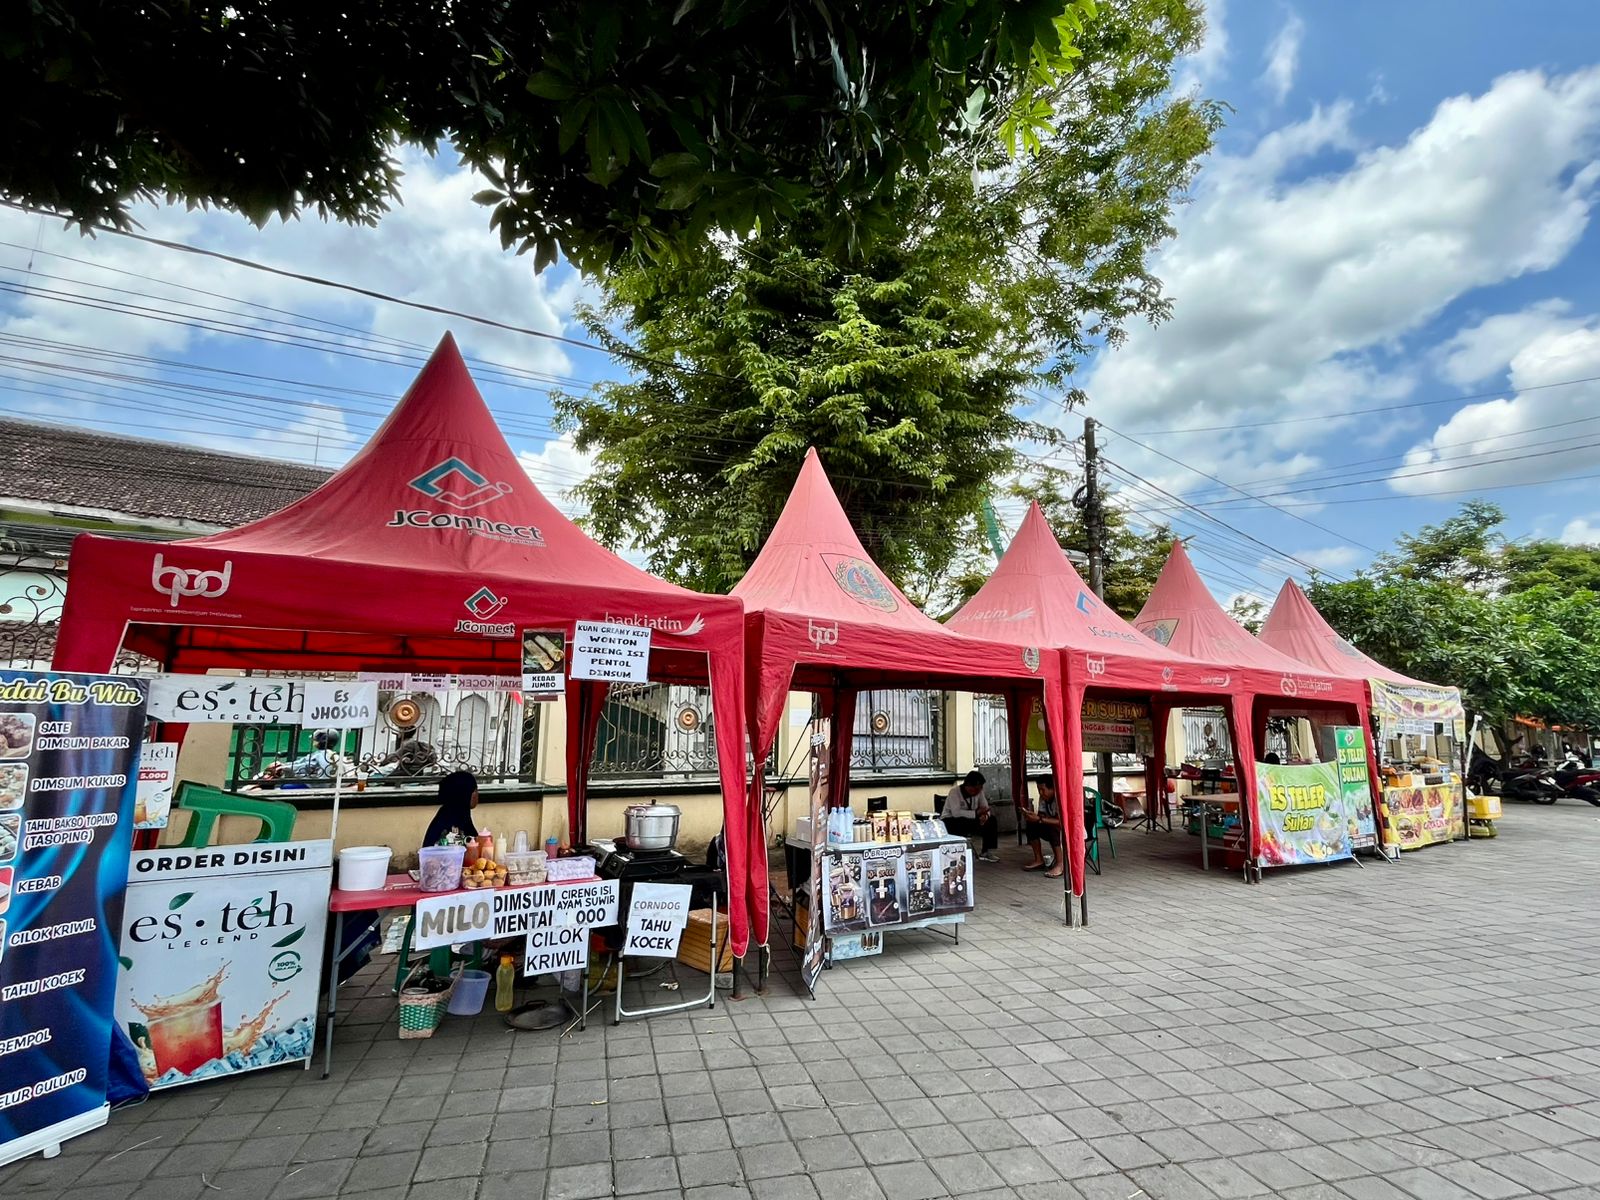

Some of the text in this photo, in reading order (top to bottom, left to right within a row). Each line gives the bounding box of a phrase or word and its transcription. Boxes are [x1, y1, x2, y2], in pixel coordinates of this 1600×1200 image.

[386, 510, 544, 541] JConnect
[454, 619, 515, 635] JConnect
[589, 635, 638, 646] WONTON
[578, 646, 645, 658] CIRENG ISI
[591, 658, 632, 668] PENTOL
[50, 681, 87, 703] Bu
[90, 683, 143, 705] Win
[207, 713, 279, 721] LEGEND
[311, 705, 369, 720] JHOSUA
[40, 722, 71, 734] SATE
[39, 737, 129, 750] DIMSUM BAKAR
[1338, 748, 1366, 764] ES TELER
[31, 775, 127, 792] DIMSUM KUKUS
[1342, 767, 1366, 783] SULTAN
[1270, 783, 1326, 811] ES TELER
[26, 814, 118, 832] TAHU BAKSO TOPING
[1282, 813, 1314, 832] Sultan
[24, 830, 95, 850] (TASOPING)
[136, 848, 306, 873] ORDER DISINI
[17, 877, 61, 893] KEBAB
[561, 885, 612, 900] CIRENG ISI
[494, 889, 556, 913] DIMSUM
[556, 895, 615, 911] AYAM SUWIR
[633, 900, 681, 911] CORNDOG
[421, 901, 490, 938] MILO
[494, 910, 553, 935] MENTAI
[640, 918, 672, 932] TAHU
[10, 918, 96, 946] CILOK KRIWIL
[532, 927, 584, 948] CILOK
[168, 932, 259, 950] LEGEND
[630, 935, 674, 950] KOCEK
[526, 949, 586, 973] KRIWIL
[2, 969, 86, 1000] TAHU KOCEK
[33, 1068, 87, 1095] GULUNG
